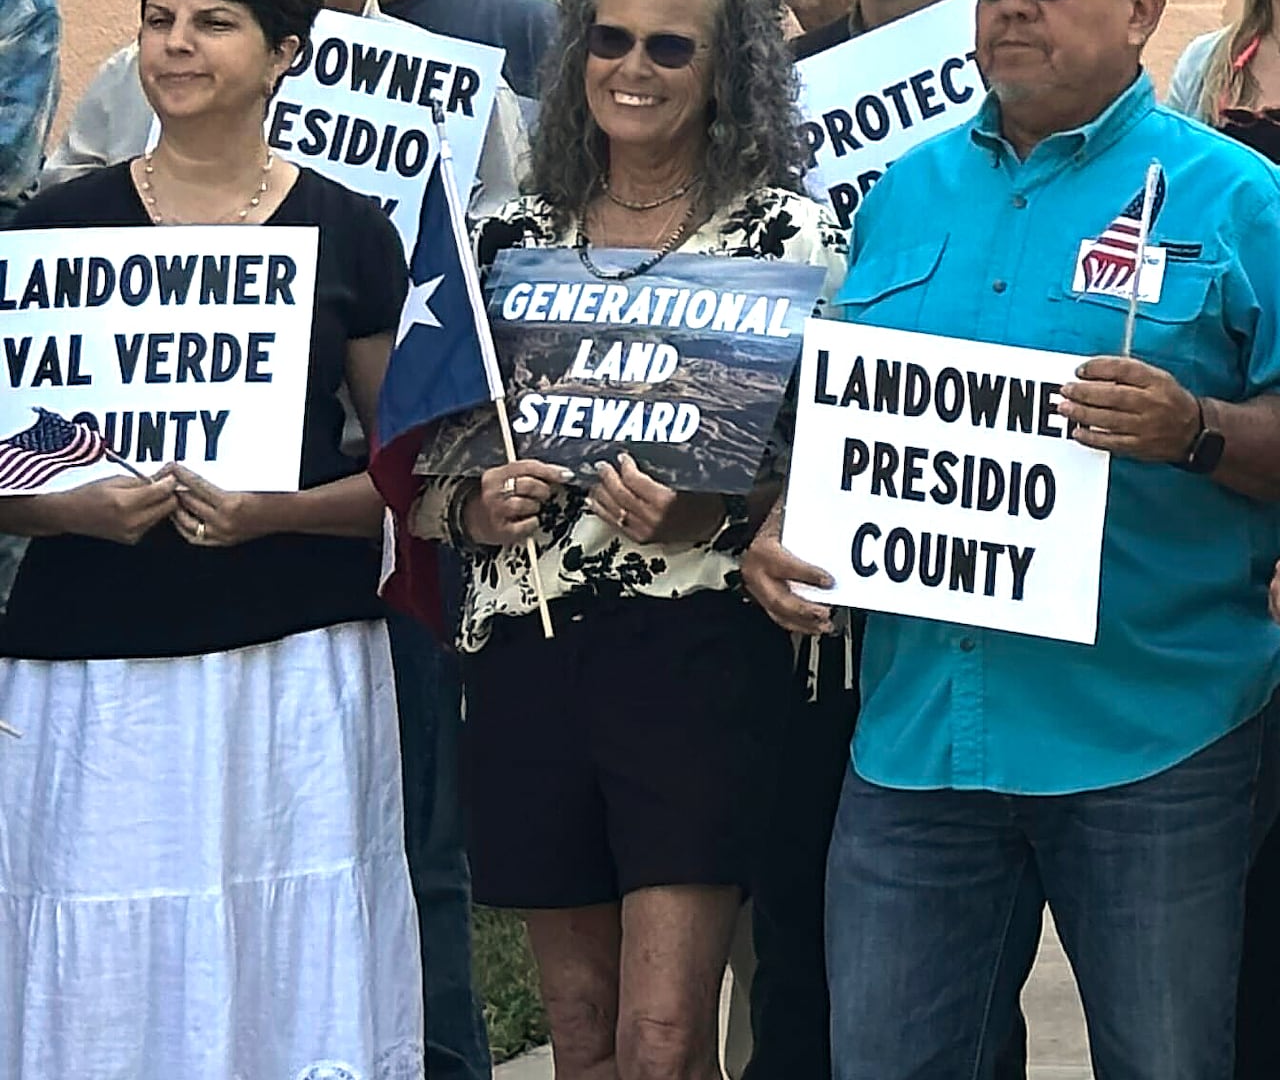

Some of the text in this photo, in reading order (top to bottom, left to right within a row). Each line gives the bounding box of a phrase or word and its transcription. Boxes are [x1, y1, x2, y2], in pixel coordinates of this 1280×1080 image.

[268, 101, 429, 178] ESIDIO
[0, 254, 298, 310] LANDOWNER
[502, 281, 793, 339] GENERATIONAL
[4, 332, 276, 388] VAL VERDE
[569, 338, 679, 384] LAND
[512, 393, 701, 444] STEWARD
[814, 349, 1080, 441] LANDOWNE
[840, 437, 1057, 521] PRESIDIO
[850, 522, 1036, 601] COUNTY
